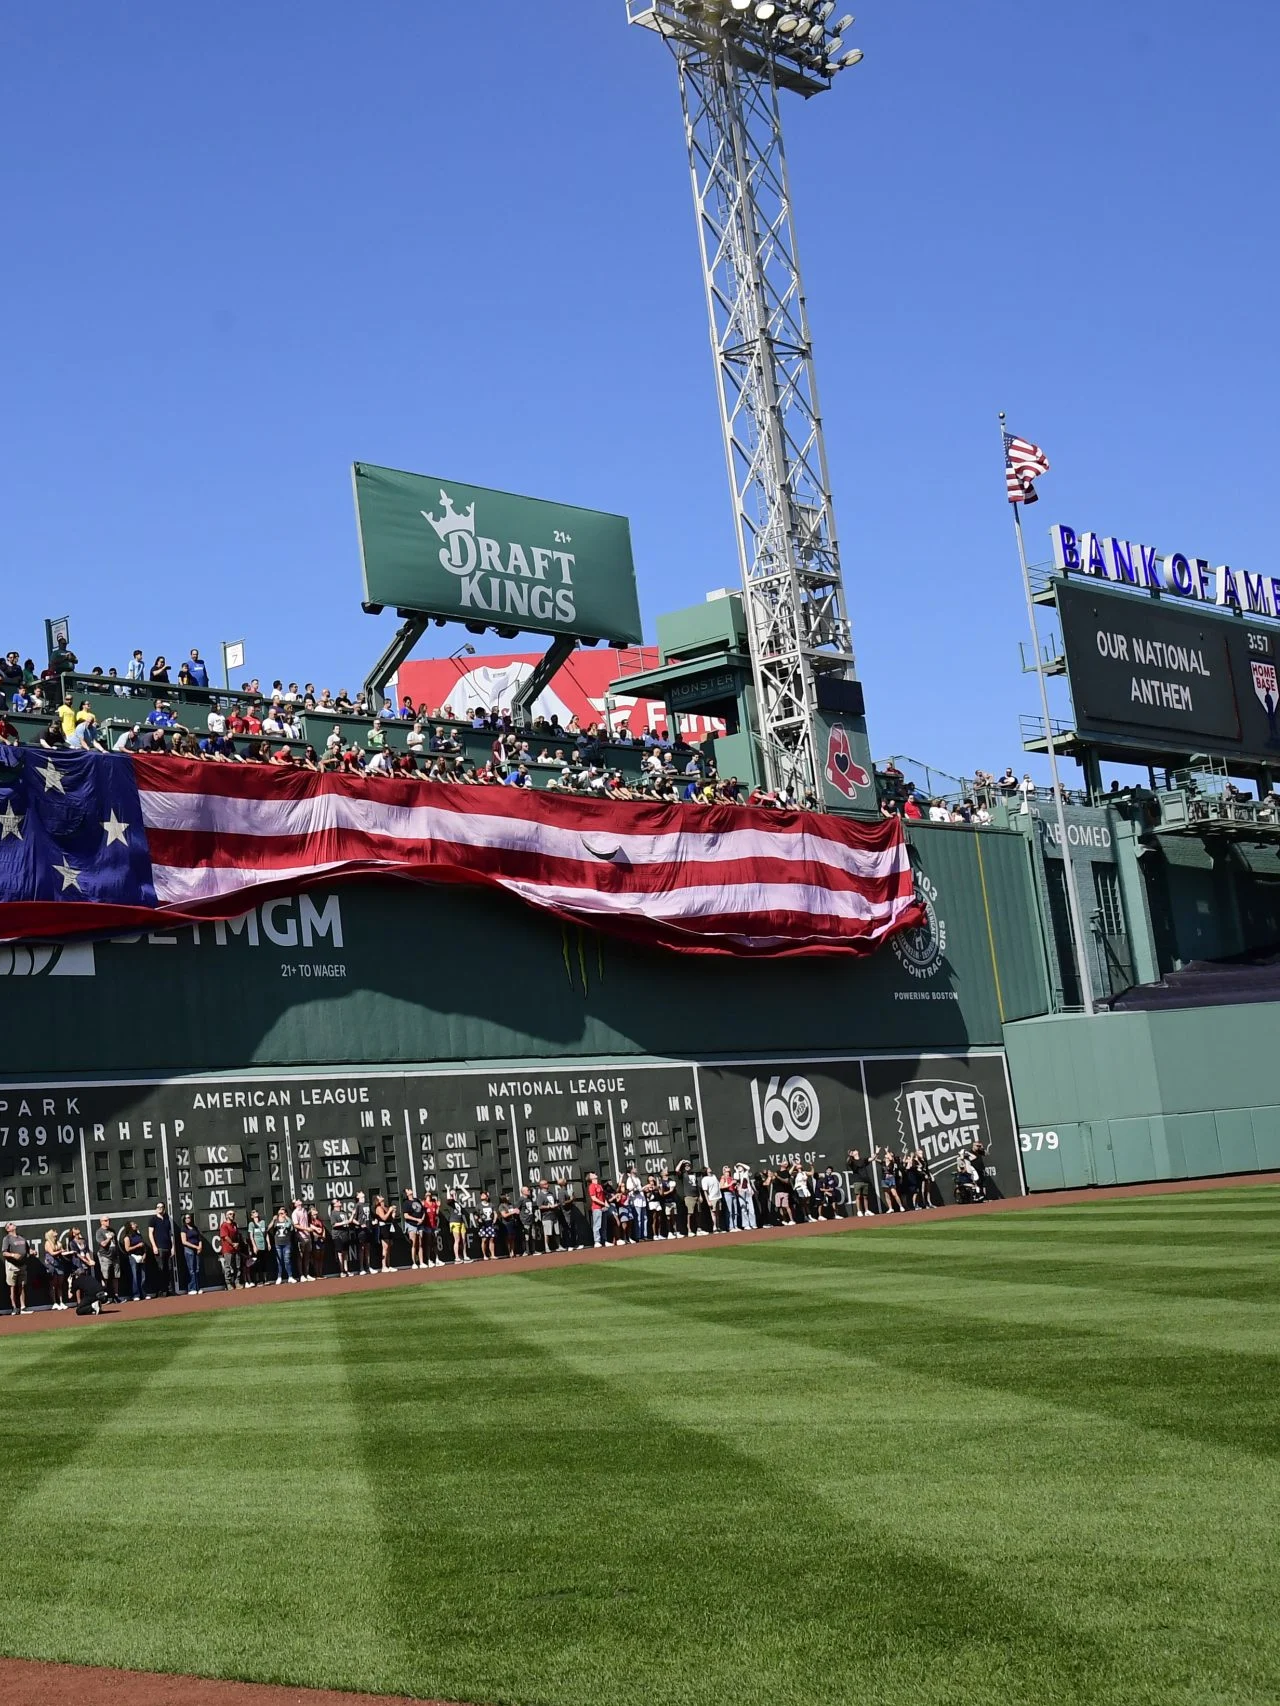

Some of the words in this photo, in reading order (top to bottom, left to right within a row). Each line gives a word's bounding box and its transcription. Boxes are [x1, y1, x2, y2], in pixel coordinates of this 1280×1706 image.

[553, 530, 572, 544] 21+
[439, 529, 576, 585] DRAFT
[1051, 524, 1161, 589] BANK
[1163, 553, 1210, 600] OF
[459, 570, 577, 623] KINGS
[1096, 630, 1129, 661] OUR
[1132, 638, 1211, 677] NATIONAL
[1247, 633, 1269, 653] 3:57
[1252, 664, 1276, 679] HOME
[1256, 678, 1277, 692] BASE
[671, 673, 734, 698] MONSTER
[1131, 677, 1193, 712] ANTHEM
[281, 964, 297, 978] 21+
[298, 964, 311, 978] TO
[313, 964, 347, 978] WAGER
[894, 991, 930, 1001] POWERING
[932, 991, 959, 1001] BOSTON
[193, 1090, 291, 1110] AMERICAN
[301, 1087, 370, 1106] LEAGUE
[488, 1079, 563, 1097] NATIONAL
[570, 1077, 625, 1094] LEAGUE
[175, 1119, 185, 1137] P
[243, 1115, 259, 1134] IN
[266, 1115, 277, 1132] R
[296, 1113, 306, 1131] P
[360, 1110, 375, 1128] IN
[381, 1109, 392, 1127] R
[419, 1108, 428, 1125] P
[476, 1105, 490, 1122] IN
[495, 1104, 505, 1121] R
[524, 1103, 533, 1119] P
[576, 1100, 590, 1116] IN
[593, 1099, 603, 1116] R
[620, 1098, 629, 1114] P
[668, 1096, 680, 1111] IN
[684, 1095, 693, 1111] R
[750, 1075, 820, 1144] 160
[914, 1088, 978, 1133] ACE
[0, 1127, 10, 1147] 7
[18, 1126, 29, 1147] 8
[35, 1125, 47, 1146] 9
[58, 1124, 75, 1145] 10
[94, 1123, 105, 1142] R
[119, 1121, 131, 1140] H
[144, 1121, 153, 1139] E
[421, 1134, 432, 1151] 21
[445, 1132, 467, 1148] CIN
[526, 1128, 536, 1144] 18
[546, 1127, 569, 1142] LAD
[622, 1122, 631, 1137] 18
[642, 1121, 663, 1136] COL
[920, 1125, 980, 1161] TICKET
[1020, 1131, 1058, 1152] 379
[207, 1146, 229, 1163] KC
[268, 1143, 278, 1161] 3
[323, 1138, 351, 1157] SEA
[446, 1153, 470, 1168] STL
[547, 1145, 573, 1161] NYM
[644, 1140, 664, 1154] MIL
[769, 1152, 800, 1166] YEARS
[804, 1151, 817, 1164] OF
[21, 1155, 49, 1176] 25
[178, 1169, 190, 1188] 12
[204, 1168, 233, 1186] DET
[270, 1164, 280, 1181] 2
[300, 1161, 310, 1180] 17
[324, 1160, 351, 1177] TEX
[453, 1173, 470, 1189] AZ
[551, 1165, 573, 1182] NYY
[645, 1158, 667, 1174] CHC
[209, 1190, 235, 1208] ATL
[301, 1184, 315, 1201] 58
[326, 1181, 353, 1199] HOU
